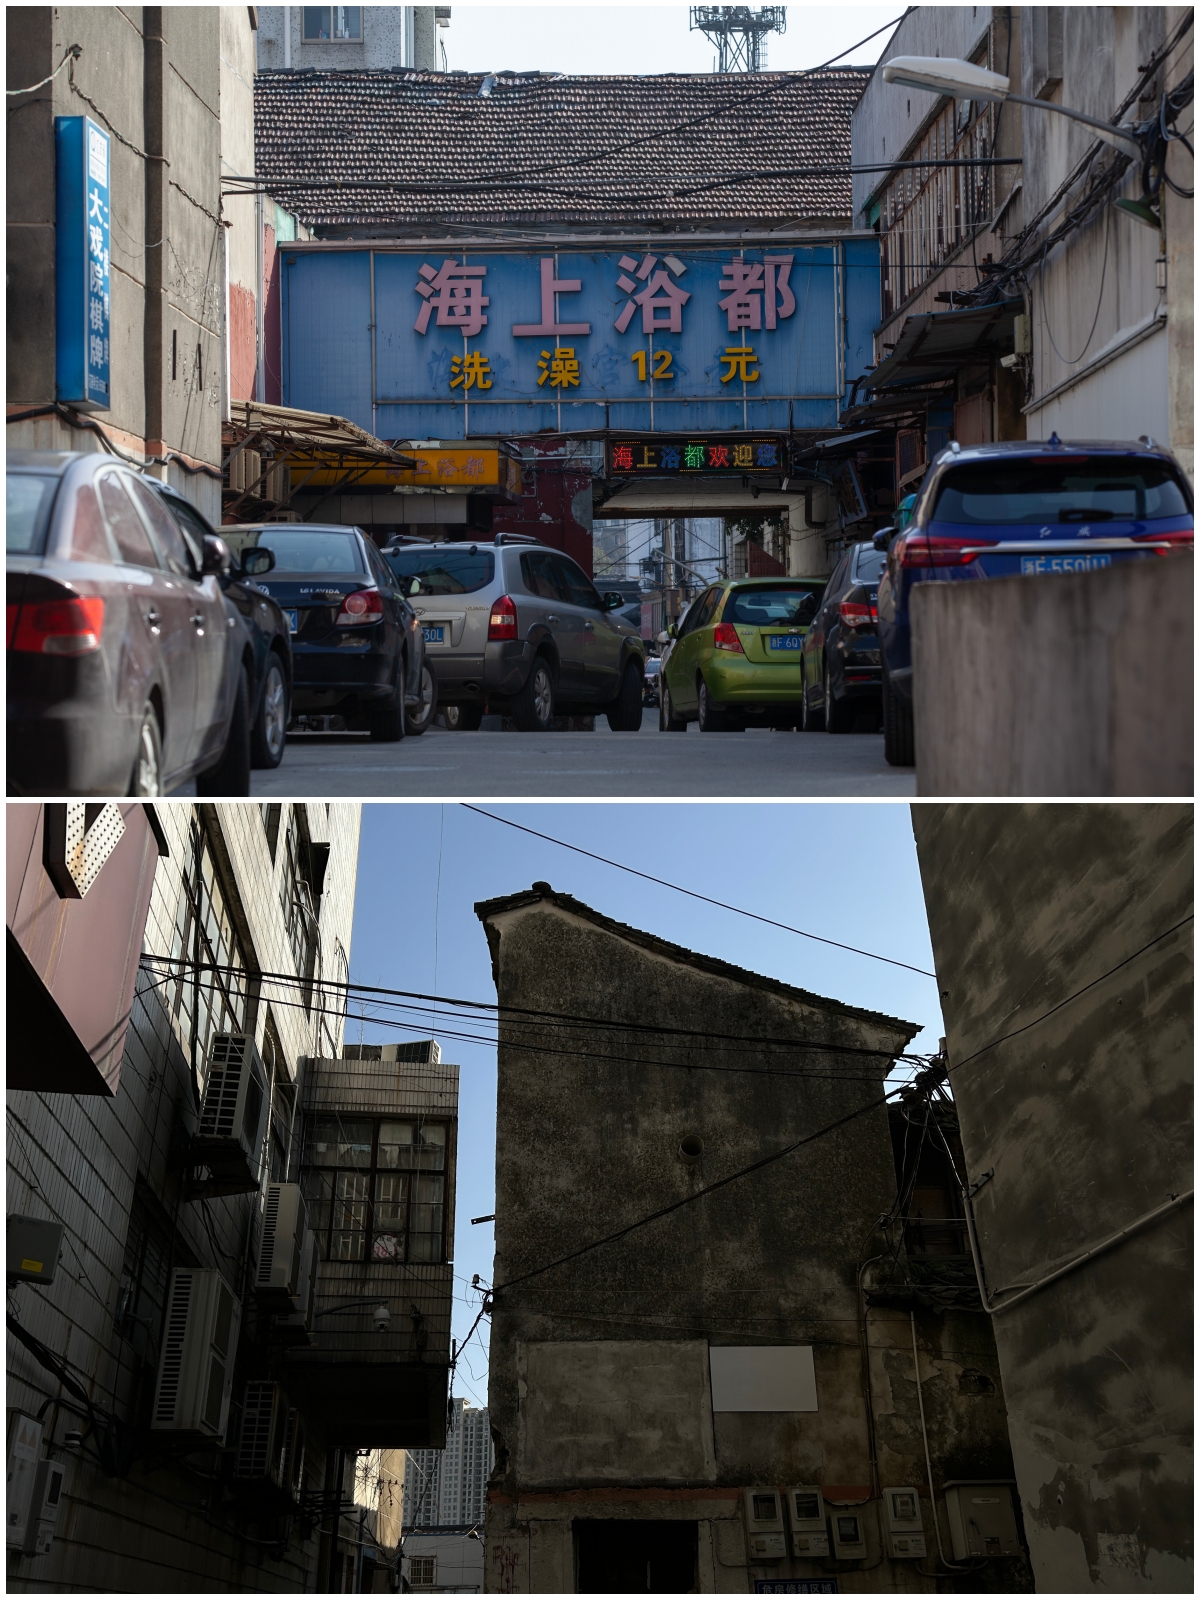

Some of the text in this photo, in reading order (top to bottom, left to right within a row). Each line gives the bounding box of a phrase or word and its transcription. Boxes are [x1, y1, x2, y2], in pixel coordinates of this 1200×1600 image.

[89, 187, 103, 370] 大戏院棋牌
[413, 254, 796, 337] 海上浴都
[449, 346, 760, 390] 洗澡12元
[612, 444, 778, 470] 海上浴都欢迎您
[309, 587, 341, 595] LAVIDA
